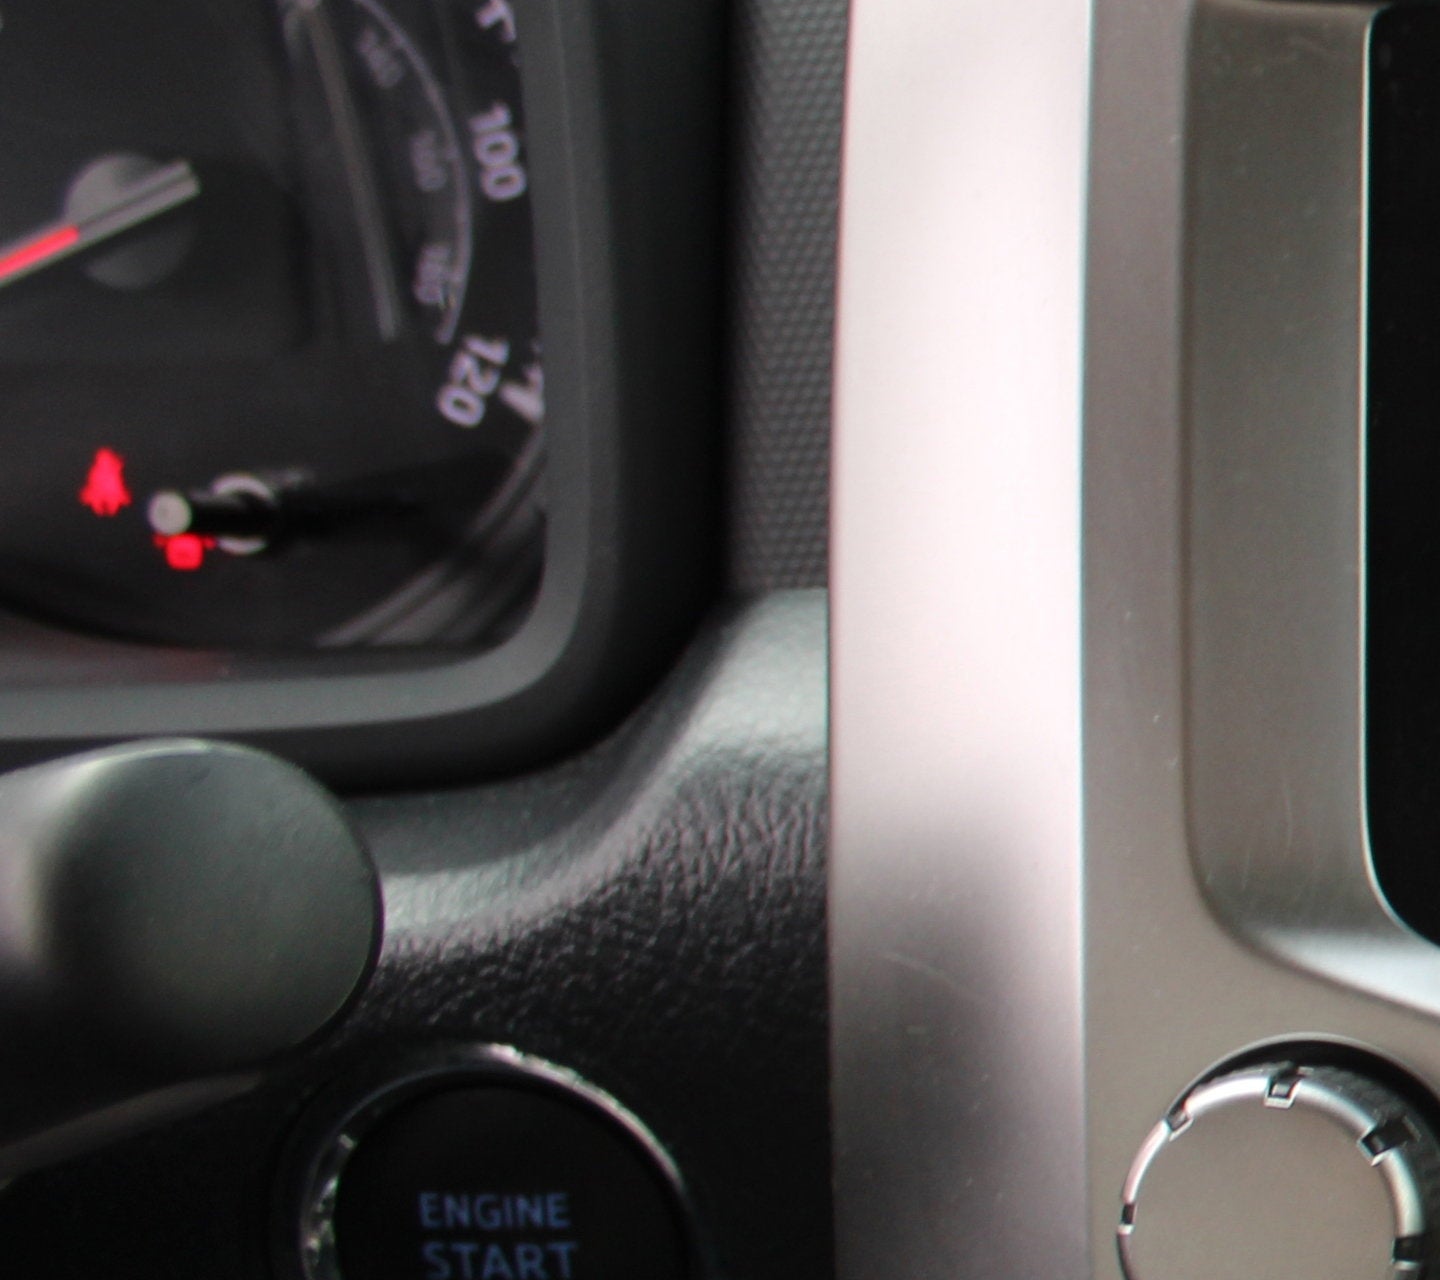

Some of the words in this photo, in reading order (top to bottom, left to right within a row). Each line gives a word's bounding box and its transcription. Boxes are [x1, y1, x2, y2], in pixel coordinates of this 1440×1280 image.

[468, 100, 526, 202] 100
[436, 332, 510, 428] 120
[418, 1192, 571, 1230] ENGINE
